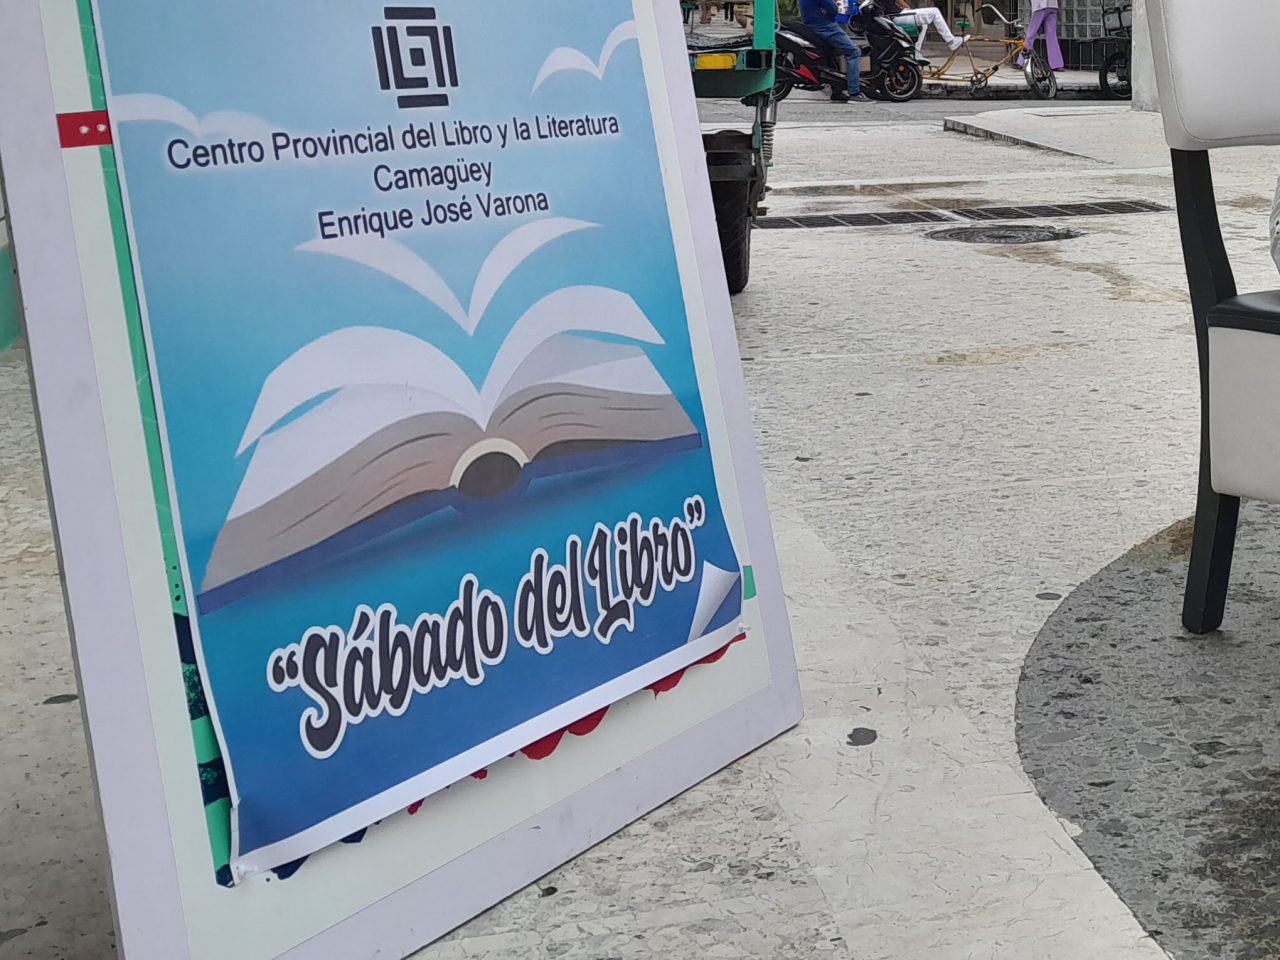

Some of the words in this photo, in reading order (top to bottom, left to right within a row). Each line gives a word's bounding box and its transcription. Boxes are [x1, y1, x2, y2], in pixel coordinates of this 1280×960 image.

[167, 136, 265, 170] Centro
[271, 124, 395, 161] Provincial
[401, 120, 437, 150] del
[442, 118, 492, 147] Libro
[497, 122, 509, 149] y
[512, 116, 531, 141] la
[535, 113, 620, 140] Literatura
[373, 158, 493, 193] Camagüey
[317, 207, 414, 240] Enrique
[420, 195, 473, 227] José
[476, 189, 550, 219] Varona
[518, 539, 588, 651] del
